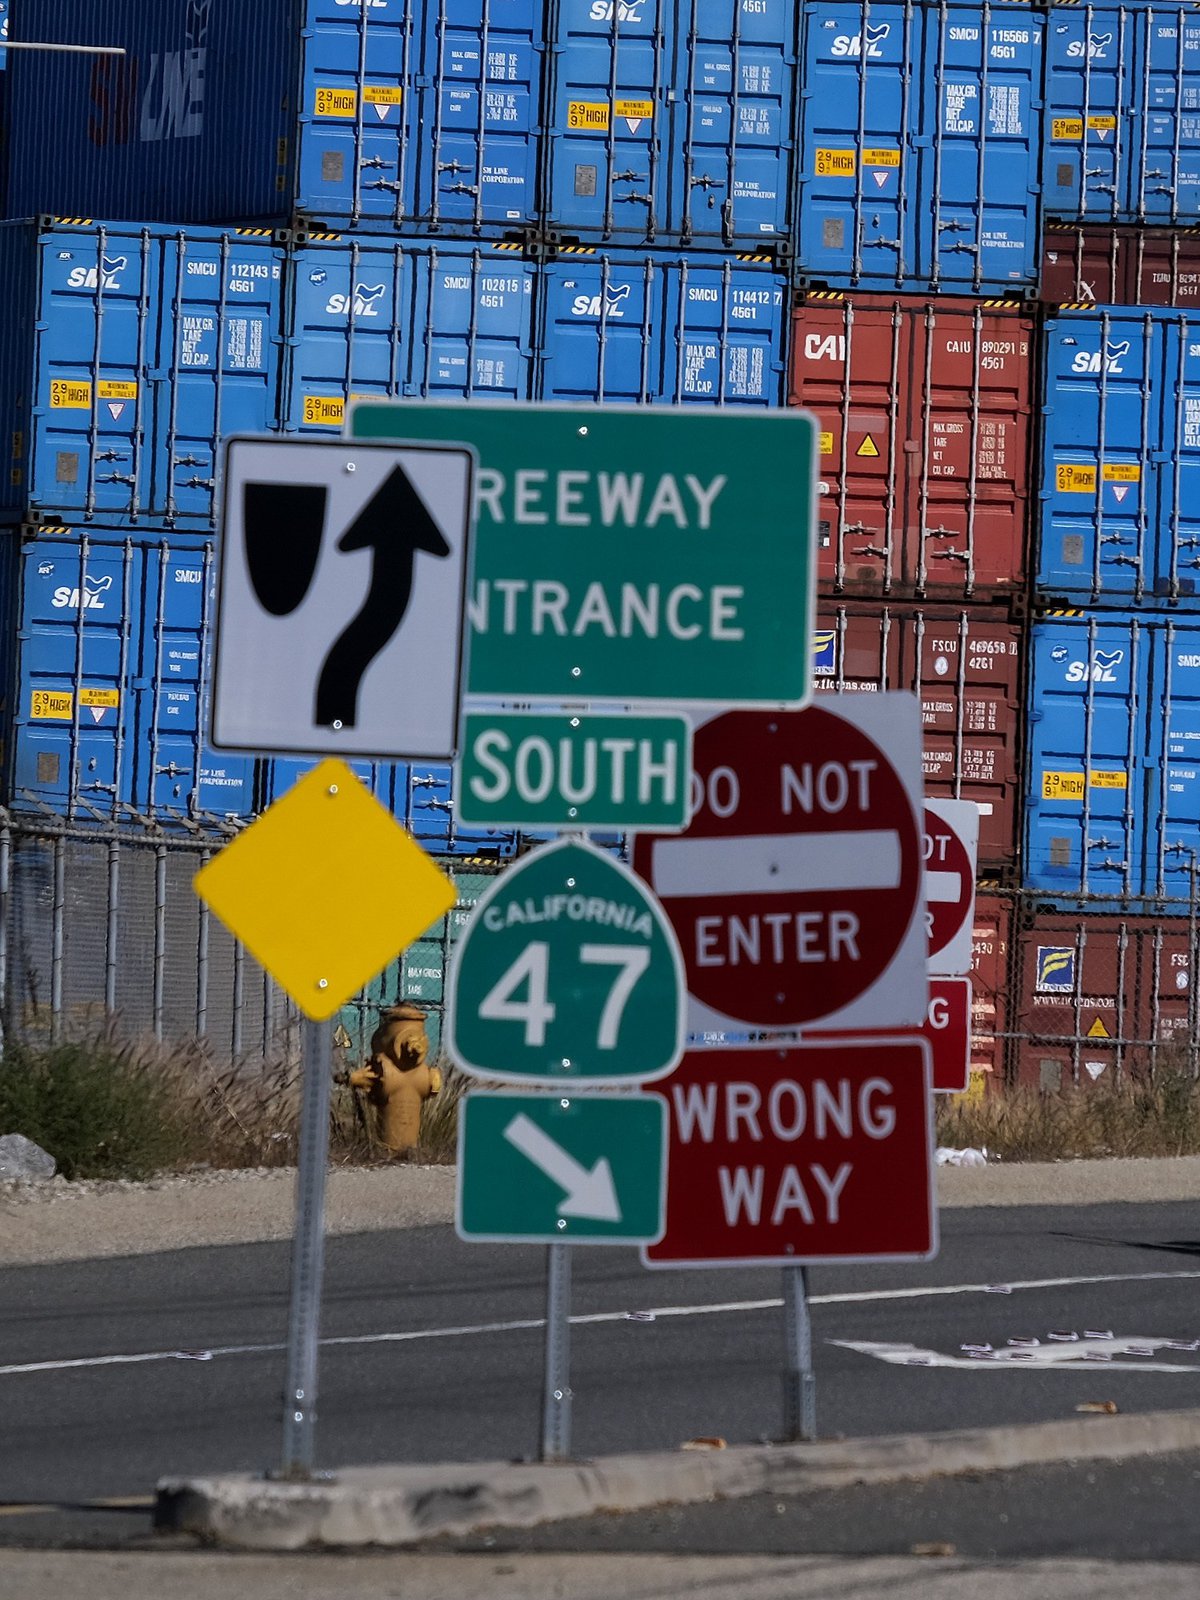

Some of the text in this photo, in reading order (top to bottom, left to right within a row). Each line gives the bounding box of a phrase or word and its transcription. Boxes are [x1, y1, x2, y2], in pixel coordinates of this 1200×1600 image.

[949, 27, 1042, 45] SMCU 115566 7
[1158, 28, 1179, 39] SMCU
[333, 97, 354, 110] HIGH
[585, 110, 607, 123] HIGH
[832, 157, 854, 171] HIGH
[481, 175, 526, 185] CORPORATION
[733, 189, 777, 200] CORPORATION
[981, 239, 1025, 249] CORPORATION
[187, 262, 280, 280] SMCU 112143 5
[444, 276, 532, 293] SMCU 102815 3
[689, 288, 782, 306] SMCU 114412 7
[946, 340, 1029, 356] CAIU 890291 3
[68, 388, 89, 402] HIGH
[321, 404, 343, 418] HIGH
[475, 466, 728, 530] REEWAY
[175, 570, 201, 584] SMCU
[467, 577, 745, 641] NTRANCE
[932, 640, 957, 654] FSCU
[49, 699, 71, 712] HIGH
[470, 729, 678, 805] SOUTH
[781, 761, 878, 815] NOT
[922, 834, 952, 861] OT
[483, 894, 652, 941] CALIFORNIA
[694, 910, 861, 967] ENTER
[478, 940, 651, 1050] 47
[671, 1076, 897, 1145] WRONG
[717, 1161, 854, 1227] WAY
